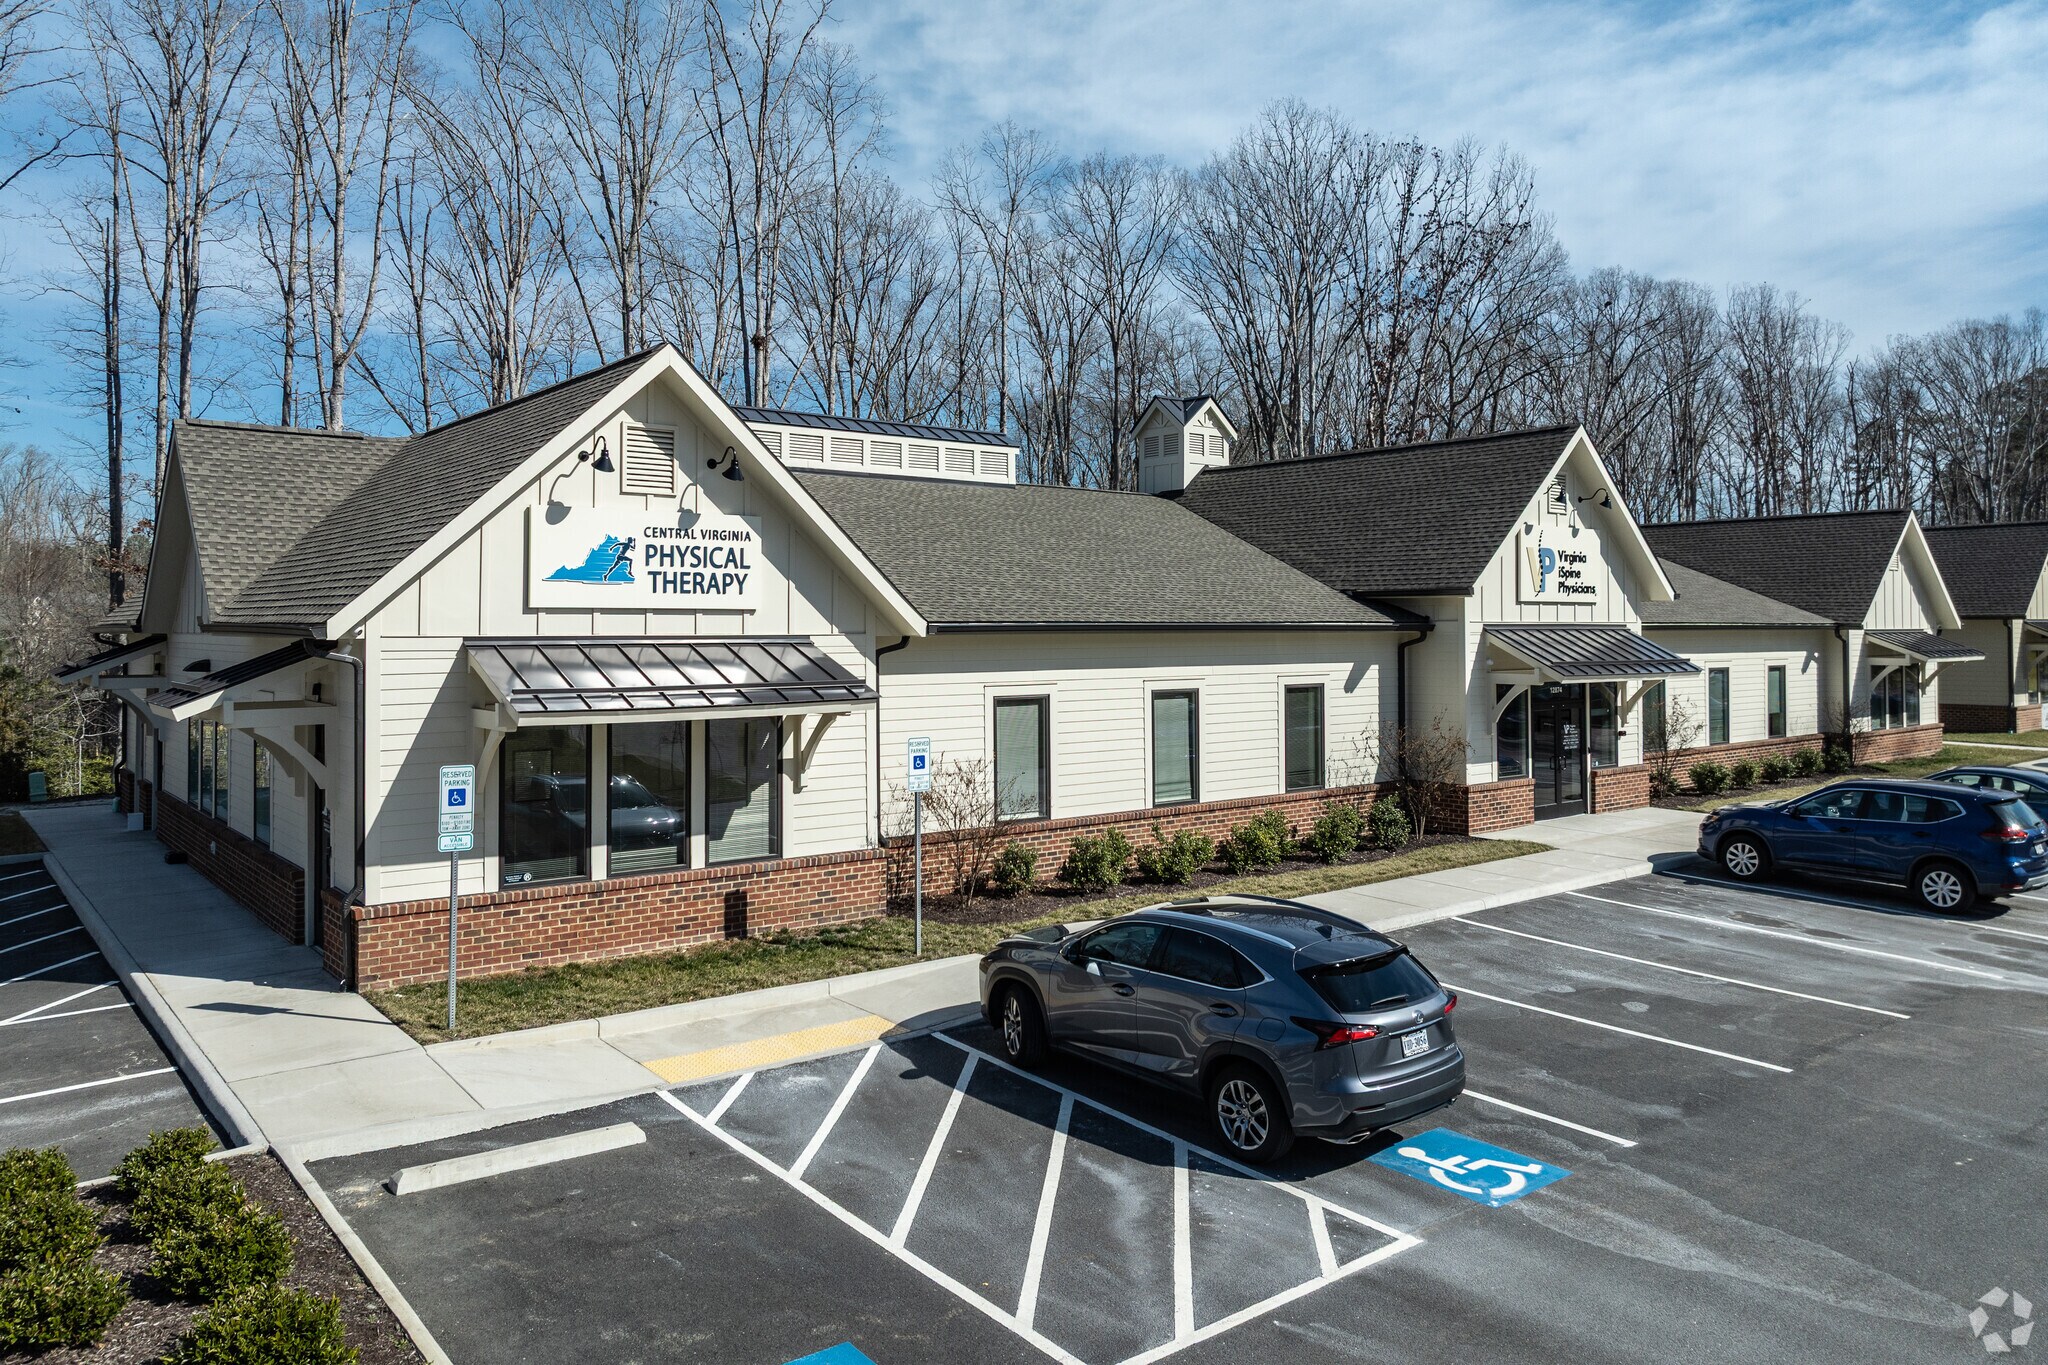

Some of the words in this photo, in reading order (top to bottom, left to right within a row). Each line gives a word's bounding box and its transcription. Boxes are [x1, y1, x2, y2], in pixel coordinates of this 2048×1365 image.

[643, 526, 697, 540] CENTRAL
[700, 529, 752, 542] VIRGINIA
[645, 544, 751, 569] PHYSICAL
[1557, 550, 1587, 565] Virginia
[1558, 566, 1581, 581] iSpine
[647, 571, 749, 595] THERAPY
[1557, 581, 1596, 597] Physicians
[442, 770, 472, 778] RESERVED
[444, 779, 471, 787] PARKING
